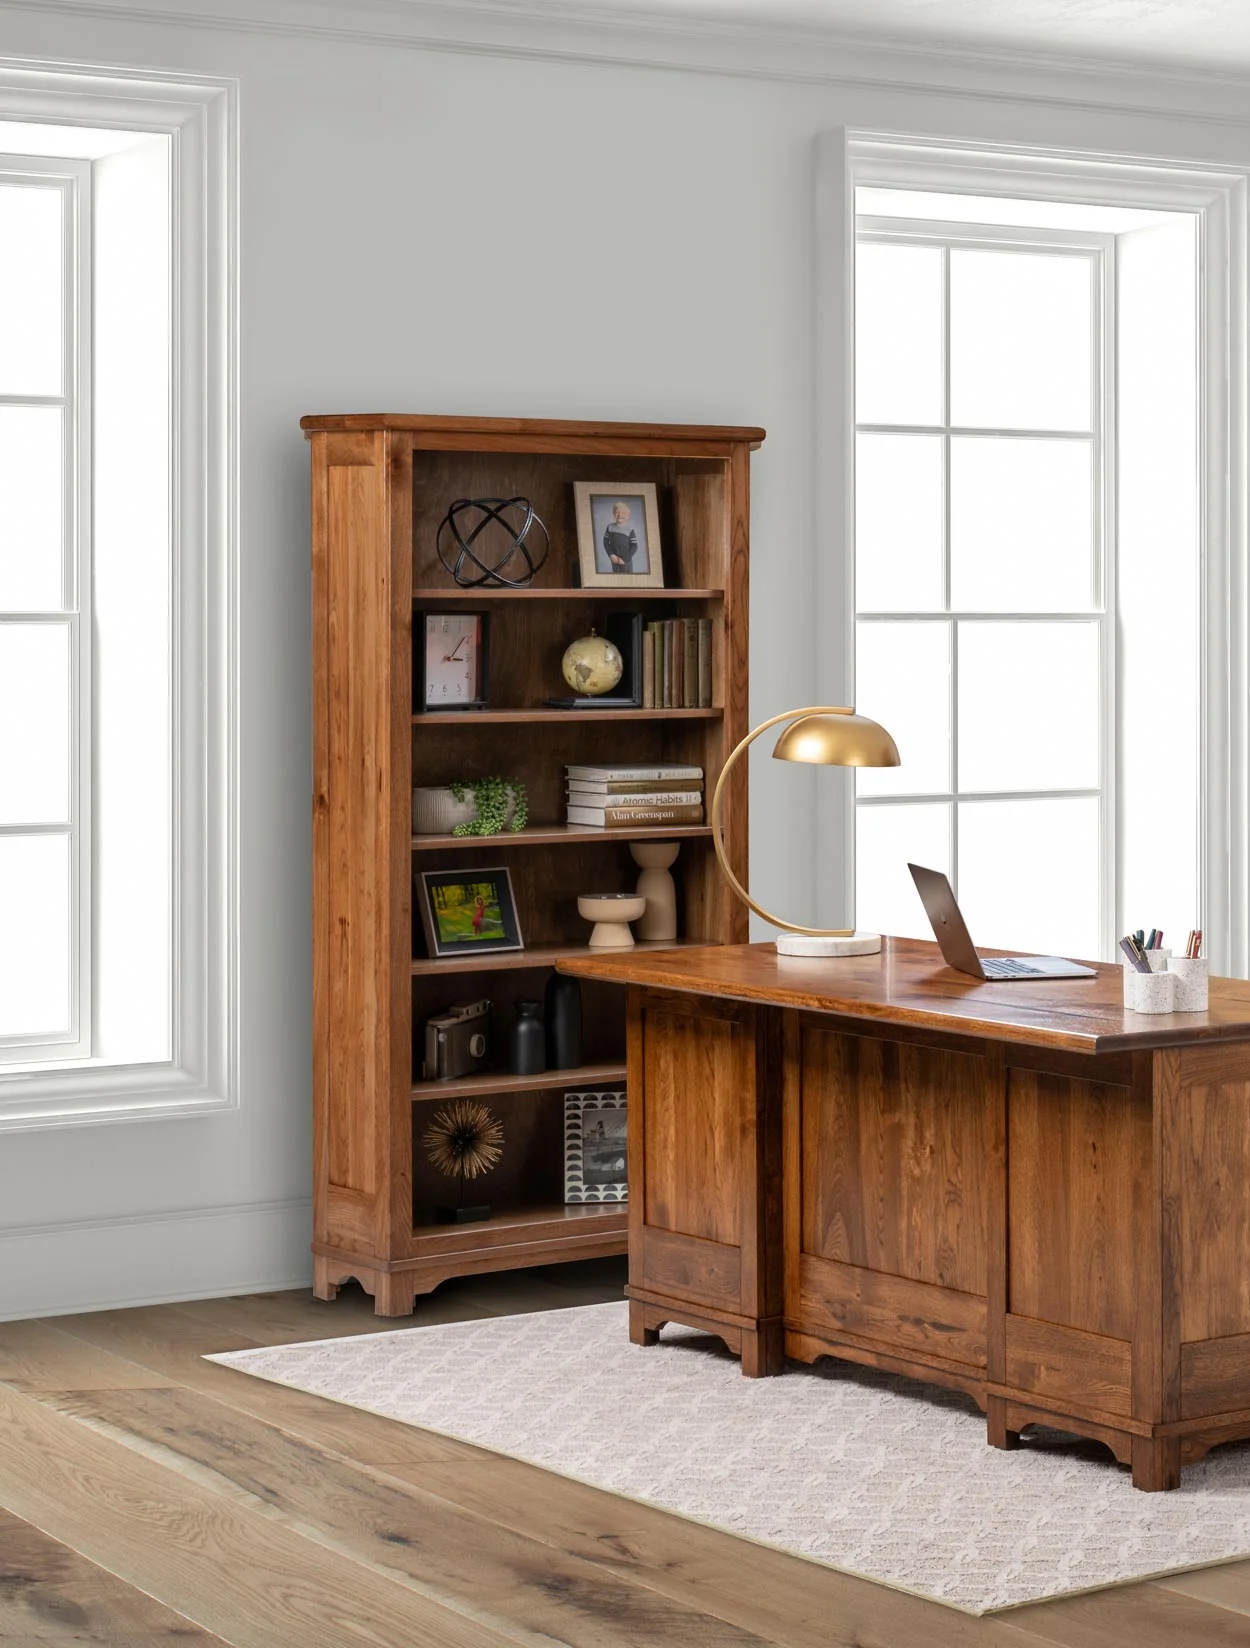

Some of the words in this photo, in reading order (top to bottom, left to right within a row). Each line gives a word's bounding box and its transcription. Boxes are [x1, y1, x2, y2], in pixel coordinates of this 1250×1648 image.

[442, 624, 449, 633] 12
[622, 797, 654, 805] Atomic
[655, 794, 683, 804] Habits
[611, 810, 630, 820] Alan
[631, 811, 674, 821] Greenspan
